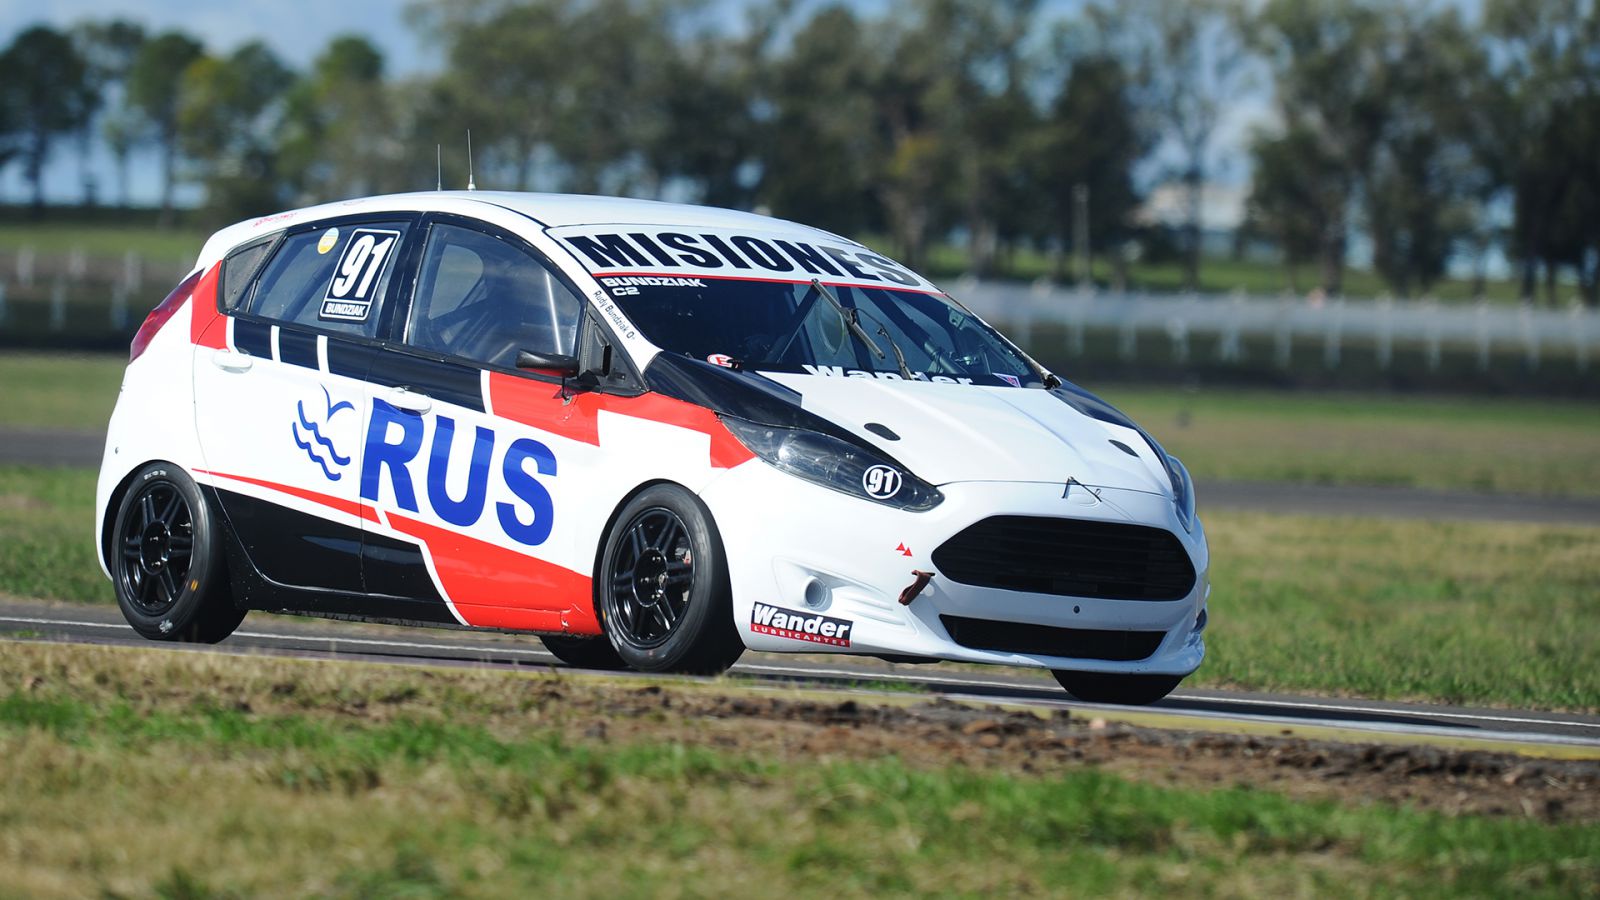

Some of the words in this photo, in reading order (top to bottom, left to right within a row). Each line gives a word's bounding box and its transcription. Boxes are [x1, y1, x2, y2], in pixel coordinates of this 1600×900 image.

[332, 235, 394, 298] 91
[564, 232, 917, 287] MISIONES
[600, 276, 708, 288] BUNDZIAK
[612, 286, 640, 296] C2
[325, 302, 366, 316] BUNDZIAK
[593, 290, 609, 308] Rudy
[605, 304, 630, 333] Bundziak
[360, 397, 557, 546] RUS
[868, 468, 894, 493] 91
[753, 604, 850, 638] Wander
[754, 625, 846, 646] LUBRICANTES
